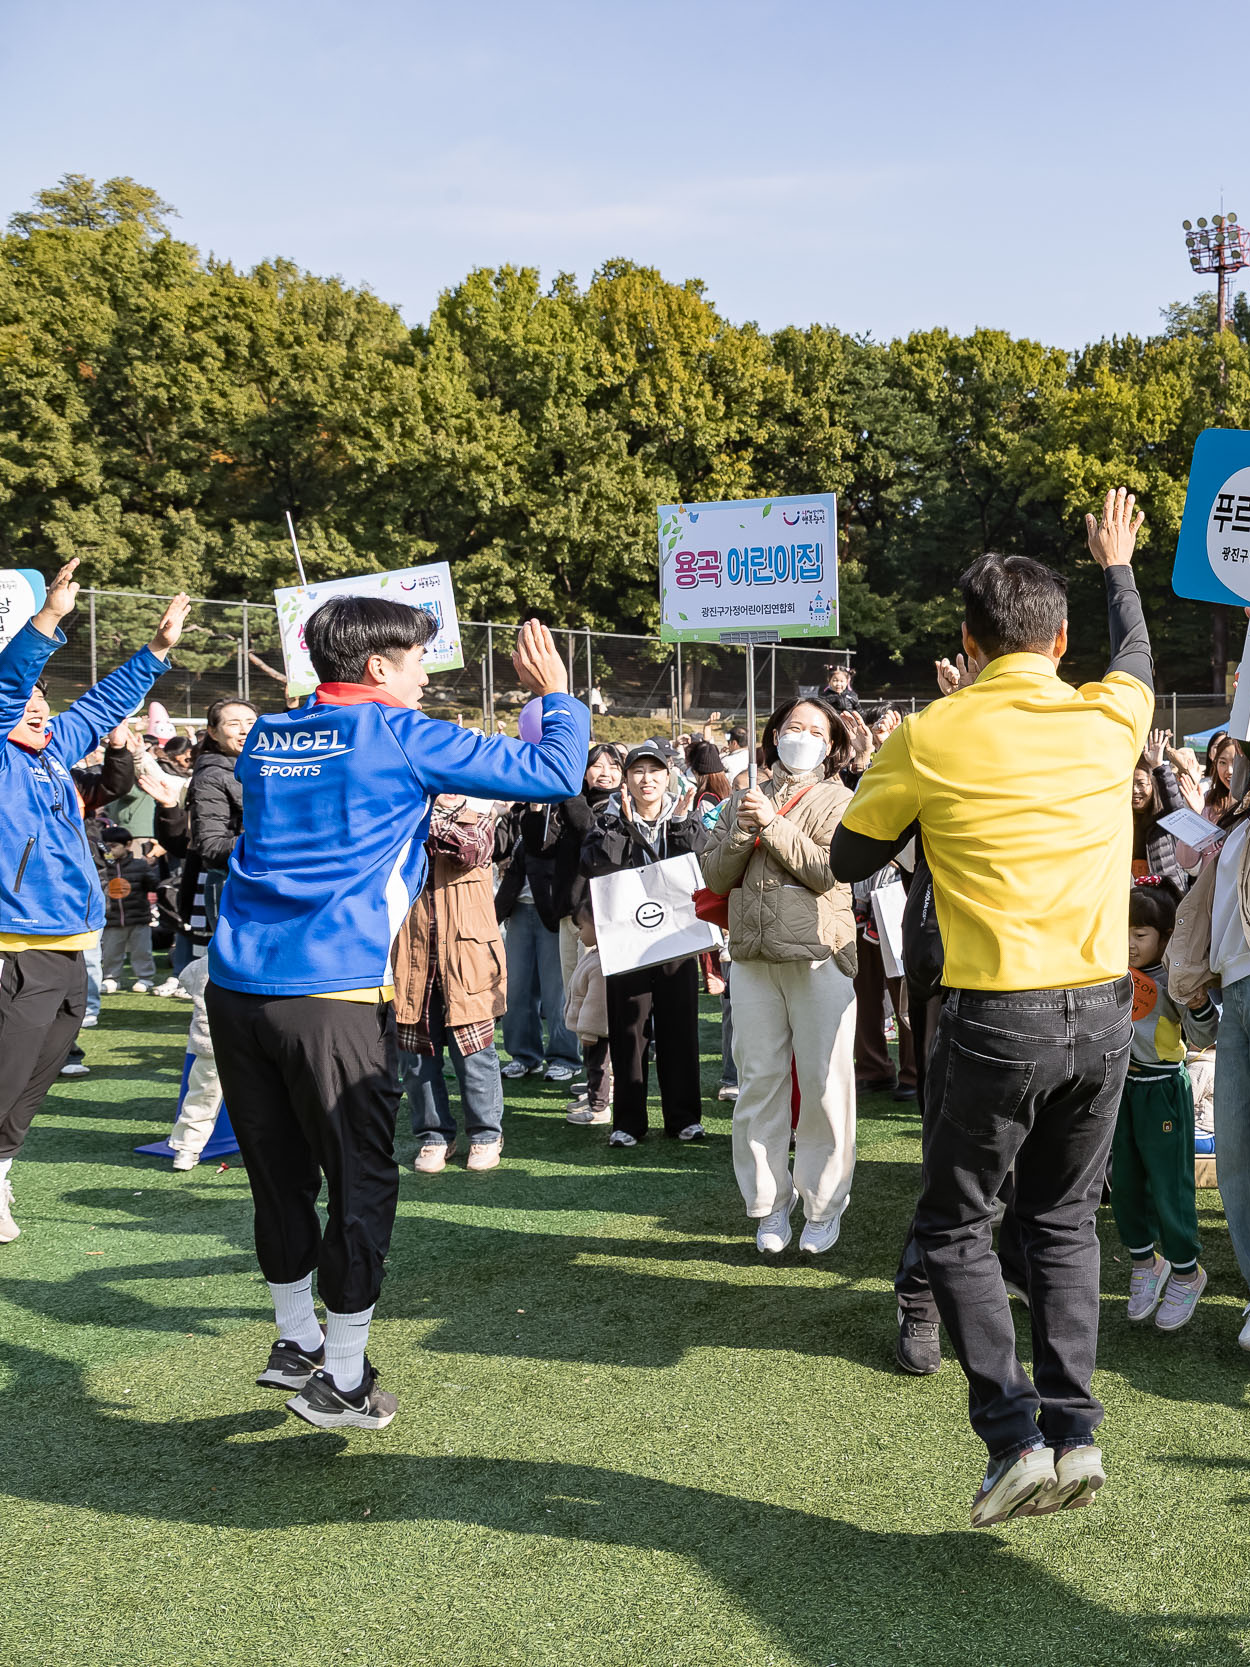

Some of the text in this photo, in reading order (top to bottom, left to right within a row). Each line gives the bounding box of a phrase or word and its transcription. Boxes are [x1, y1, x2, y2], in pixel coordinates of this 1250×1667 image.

[674, 543, 824, 589] 용곡 어린이집
[700, 602, 796, 618] 광진구가정어린이집연합회
[251, 729, 347, 752] ANGEL
[259, 764, 322, 777] SPORTS
